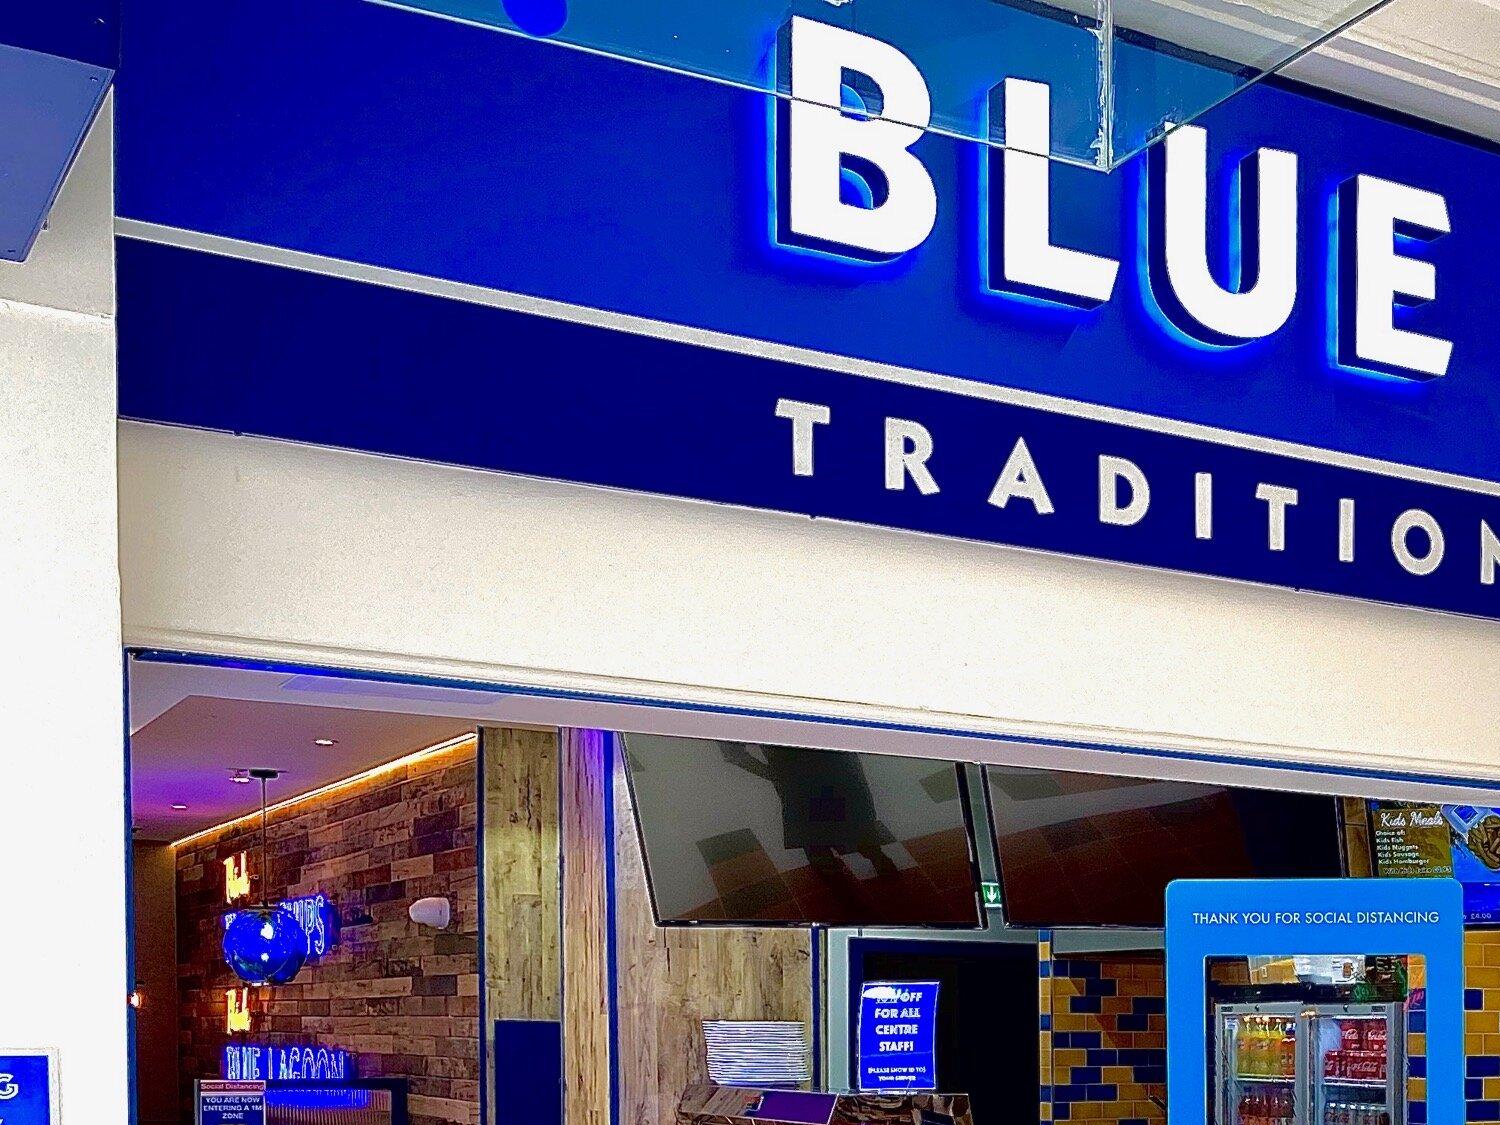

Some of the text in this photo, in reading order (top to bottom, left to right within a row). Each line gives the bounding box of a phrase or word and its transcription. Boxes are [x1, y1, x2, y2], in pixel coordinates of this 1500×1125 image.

[788, 16, 1453, 377] BLUE
[1380, 811, 1443, 827] Kids Meals
[1193, 911, 1440, 925] THANK YOU FOR SOCIAL DISTANCING
[874, 1007, 921, 1019] FOR ALL
[875, 1024, 919, 1035] CENTRE
[879, 1041, 914, 1052] STAFF!
[225, 1083, 264, 1091] Distancing
[205, 1096, 223, 1104] YOU
[203, 1104, 243, 1112] ENTERING
[222, 1112, 245, 1120] ZONE
